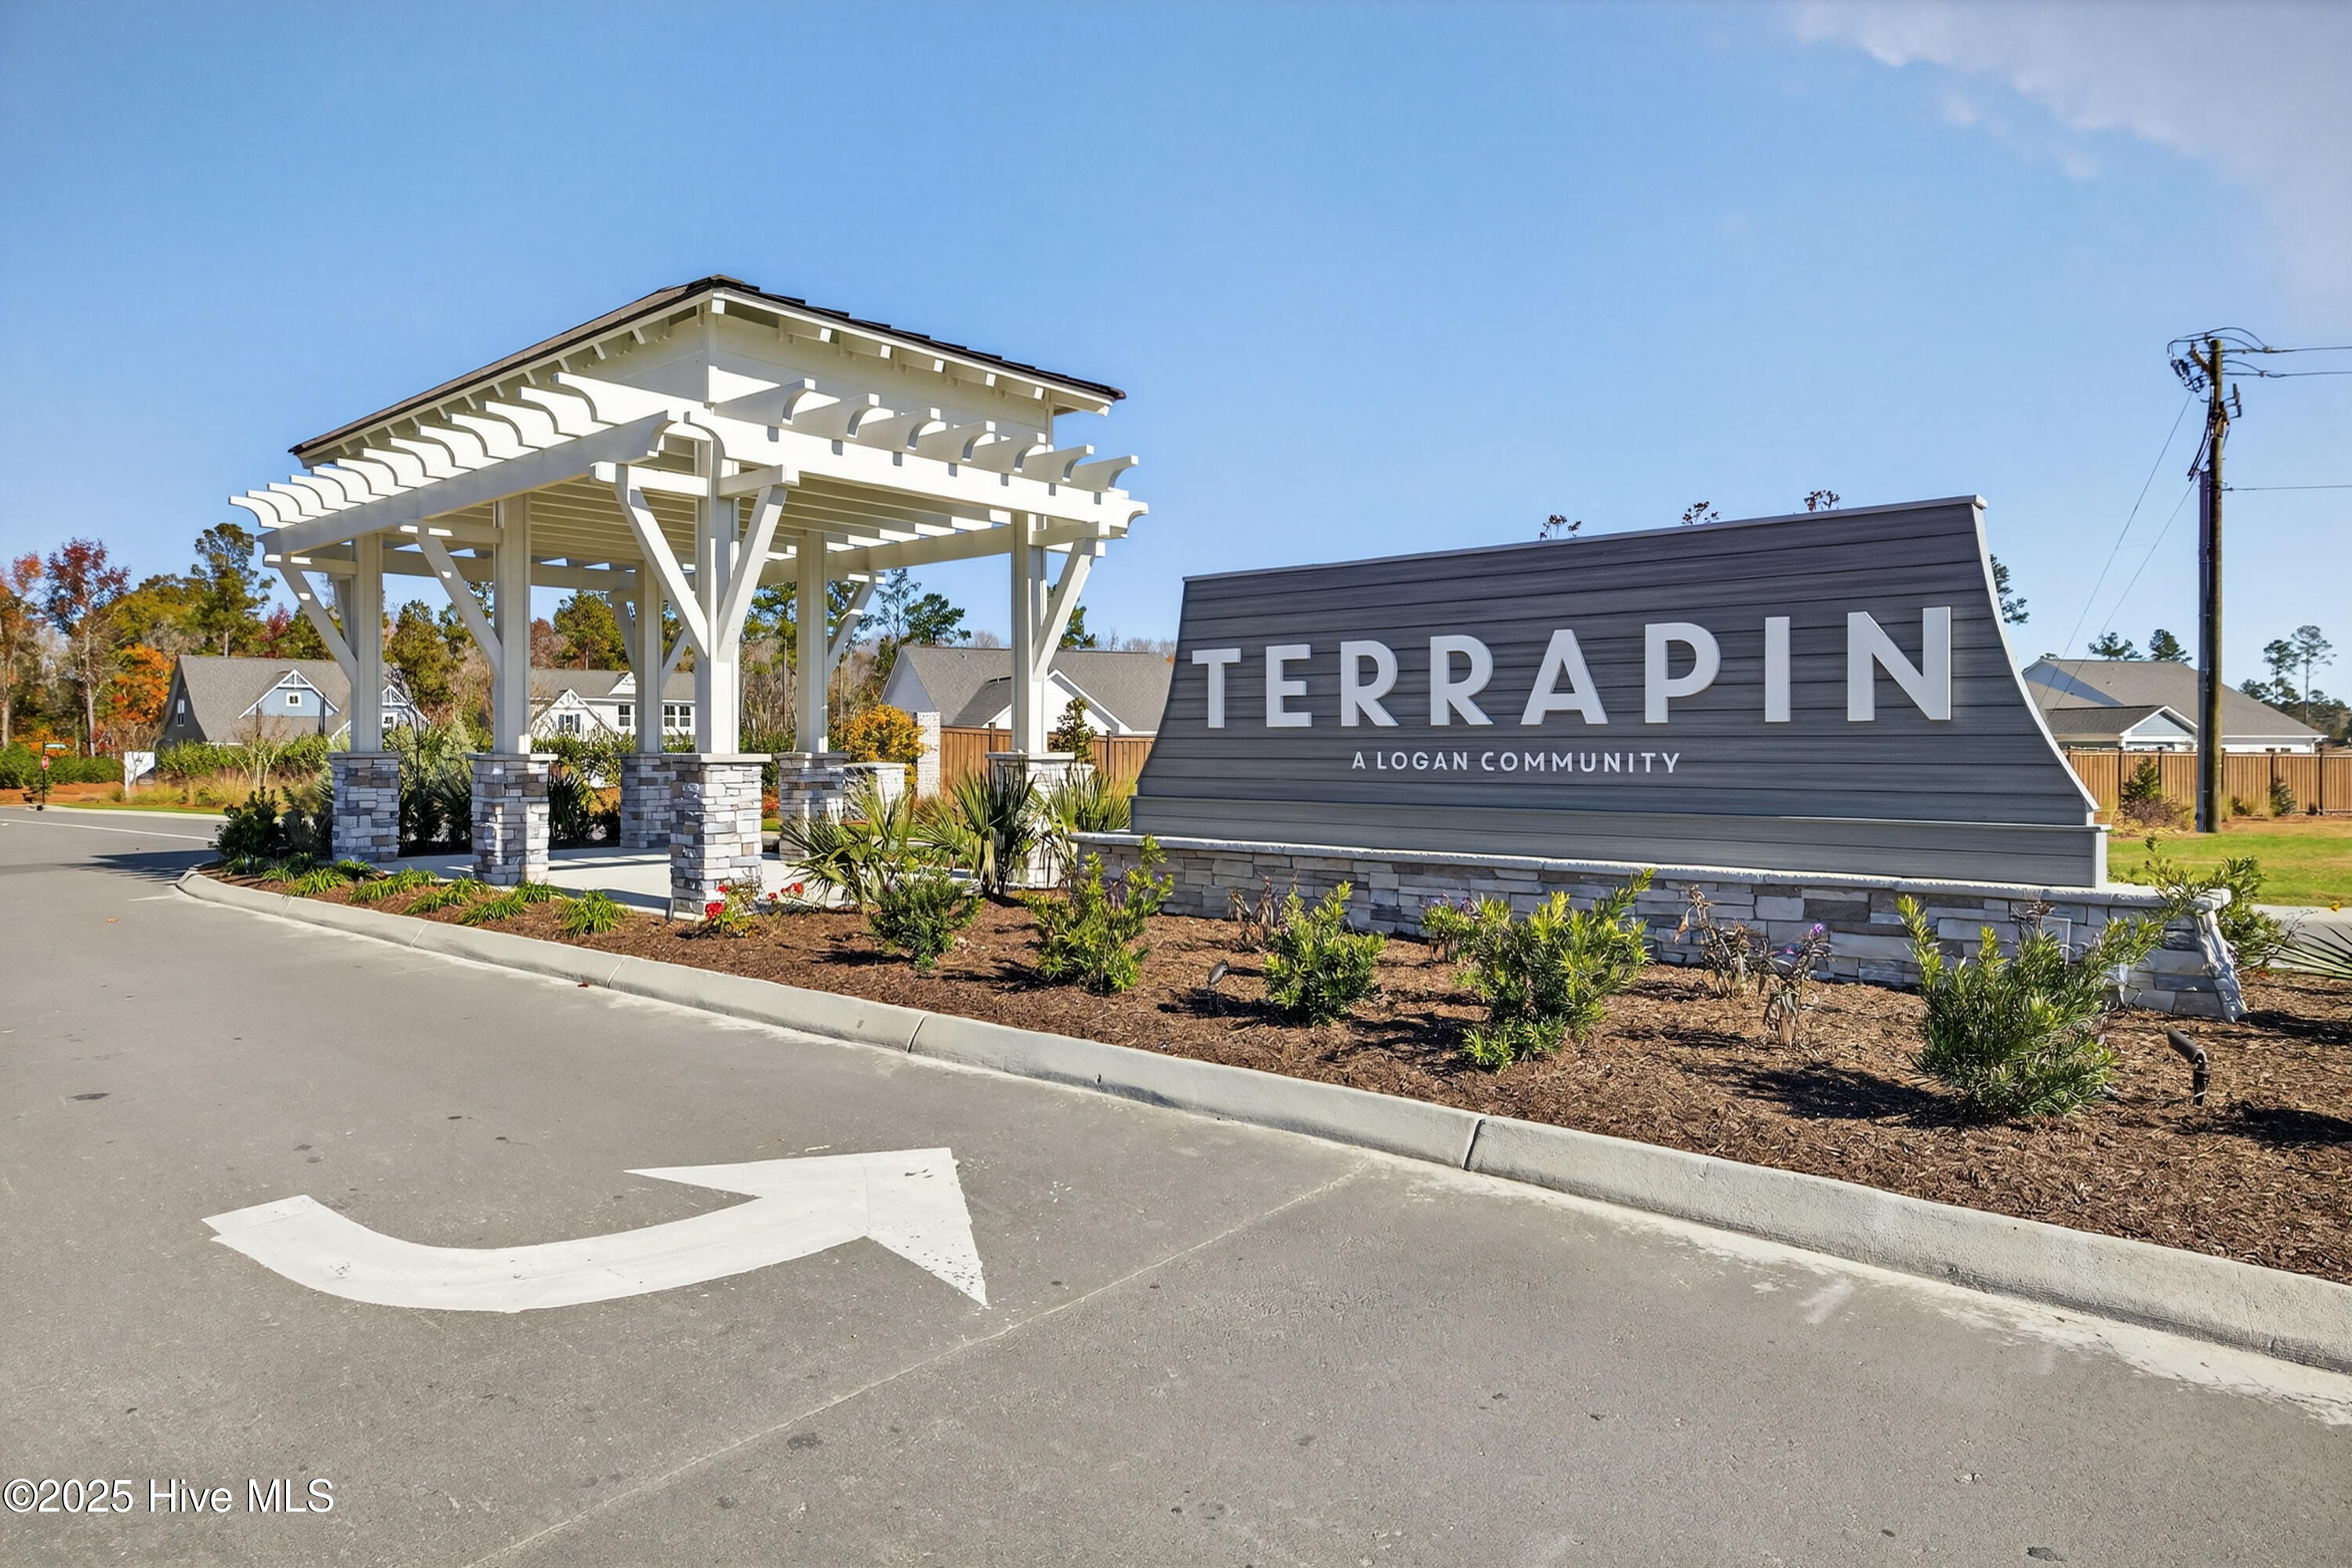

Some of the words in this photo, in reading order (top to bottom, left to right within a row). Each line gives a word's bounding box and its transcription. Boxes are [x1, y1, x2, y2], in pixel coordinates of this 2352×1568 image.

[1191, 605, 1952, 730] TERRAPIN
[1351, 751, 1367, 770] A
[1376, 750, 1468, 771] LOGAN
[1480, 751, 1681, 774] COMMUNITY
